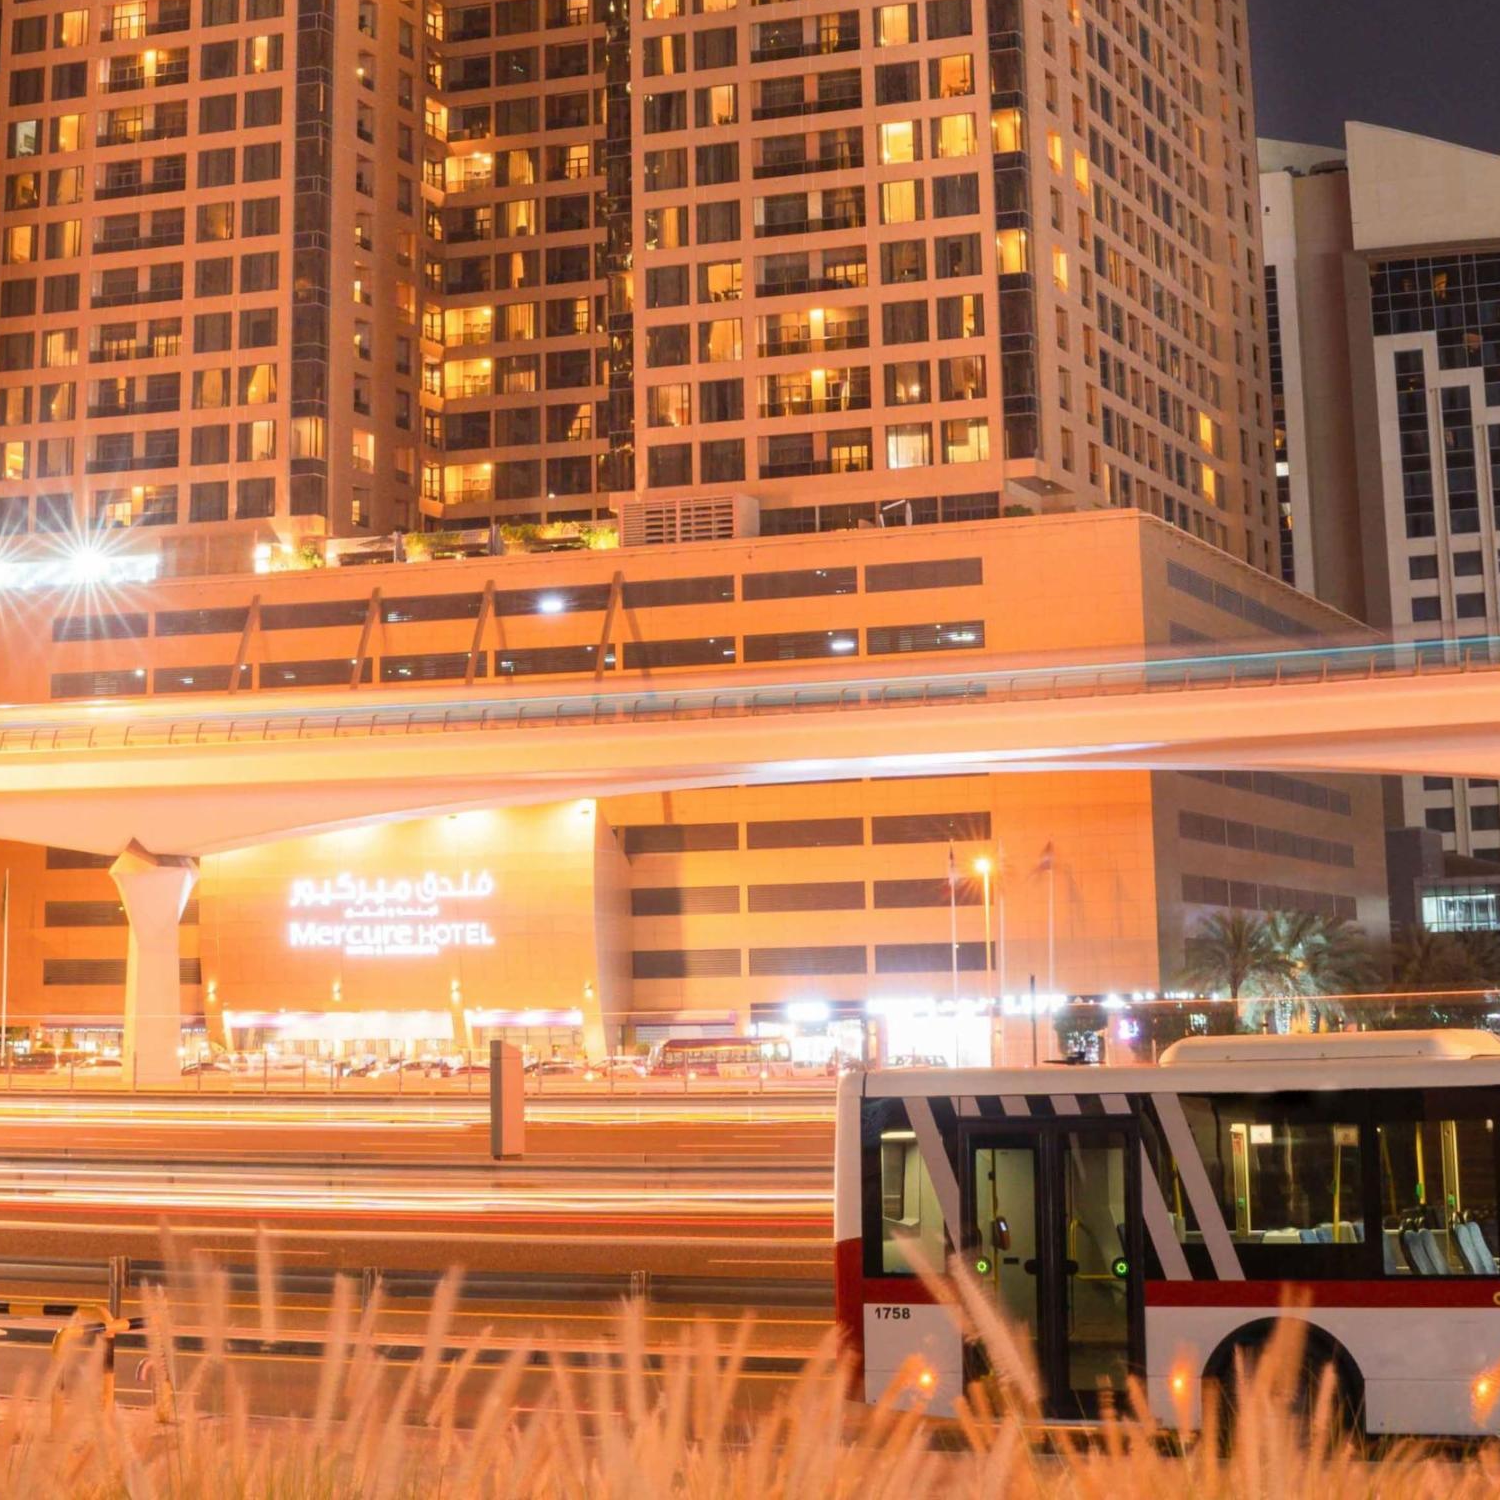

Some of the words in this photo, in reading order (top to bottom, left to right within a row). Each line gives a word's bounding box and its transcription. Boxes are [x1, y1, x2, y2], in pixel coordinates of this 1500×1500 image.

[416, 870, 494, 904] فندق
[289, 922, 412, 947] Mercure
[419, 922, 495, 946] HOTEL
[874, 1306, 911, 1320] 1758
